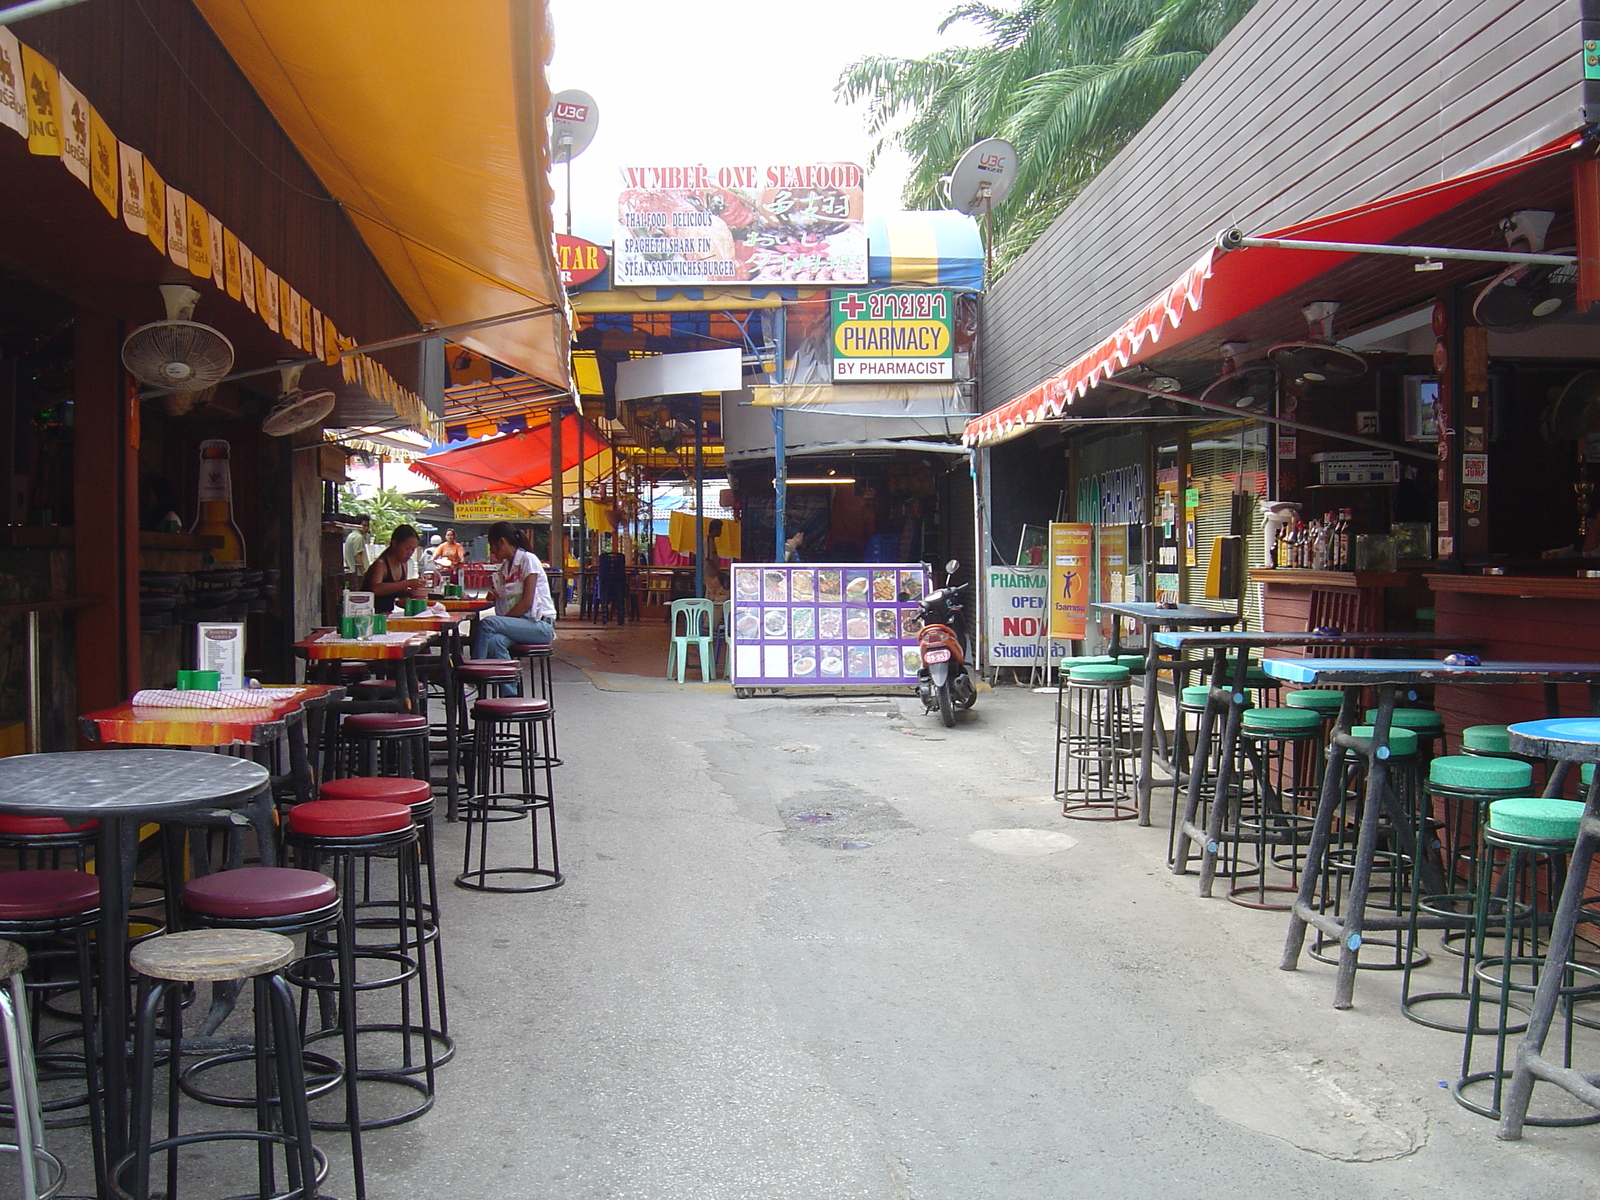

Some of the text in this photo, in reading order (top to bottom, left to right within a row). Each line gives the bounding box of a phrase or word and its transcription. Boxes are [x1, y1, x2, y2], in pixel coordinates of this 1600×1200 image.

[29, 118, 60, 141] ING
[625, 165, 861, 190] NUMBER ONE SEAFOOD
[672, 212, 713, 227] DELICIOUS
[698, 238, 711, 253] FIN
[560, 245, 599, 270] TAR
[868, 294, 947, 319] ขายยา
[843, 326, 942, 351] PHARMACY
[838, 362, 946, 375] BY PHARMACIST
[990, 573, 1047, 588] PHARMA
[993, 642, 1066, 658] ร้านยาเปิดล้ว
